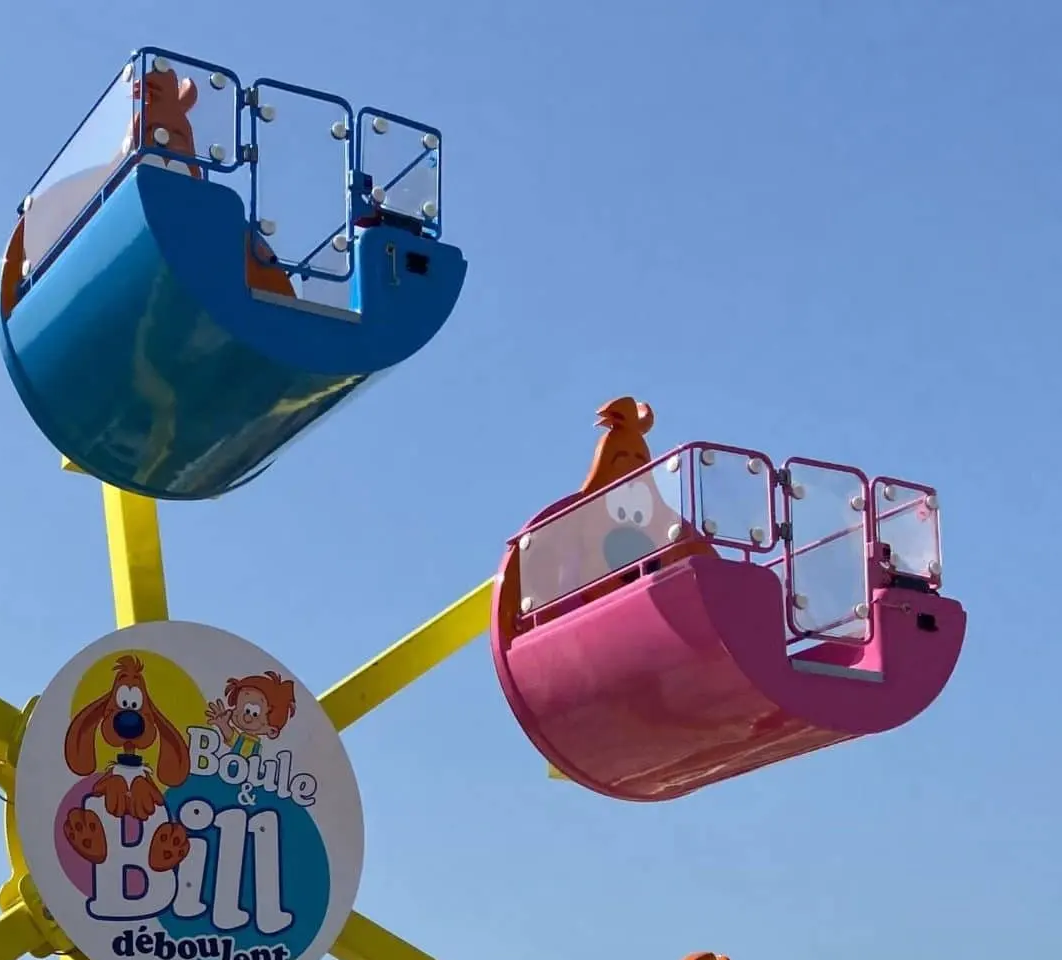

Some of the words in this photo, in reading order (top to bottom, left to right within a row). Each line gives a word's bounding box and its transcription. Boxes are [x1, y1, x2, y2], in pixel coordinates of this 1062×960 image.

[187, 726, 318, 808] Boule
[237, 782, 258, 806] &
[83, 793, 294, 935] Bill
